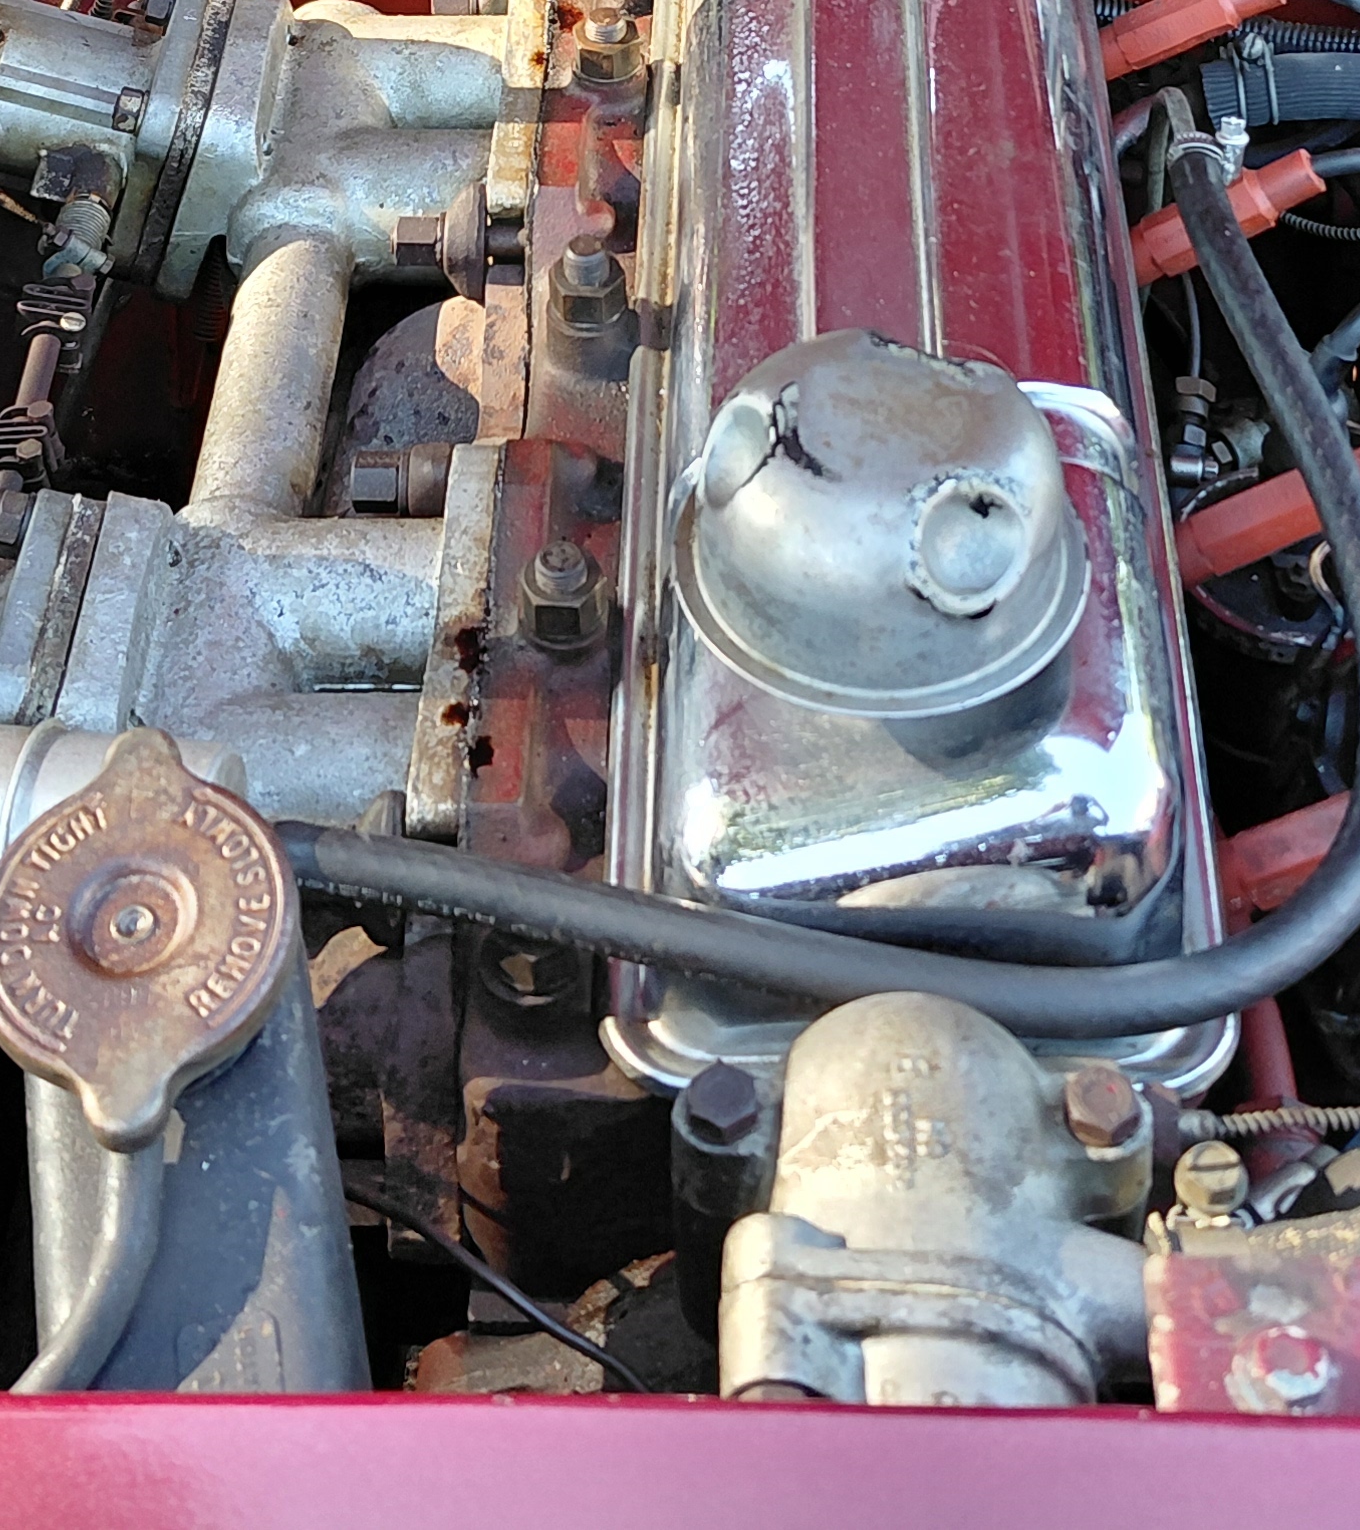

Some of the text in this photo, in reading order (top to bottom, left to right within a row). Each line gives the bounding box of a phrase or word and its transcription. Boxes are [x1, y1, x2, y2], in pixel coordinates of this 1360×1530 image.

[30, 791, 108, 872] TIGHT
[182, 801, 272, 1019] REMOVE SLOWLY
[4, 970, 80, 1041] TURN
